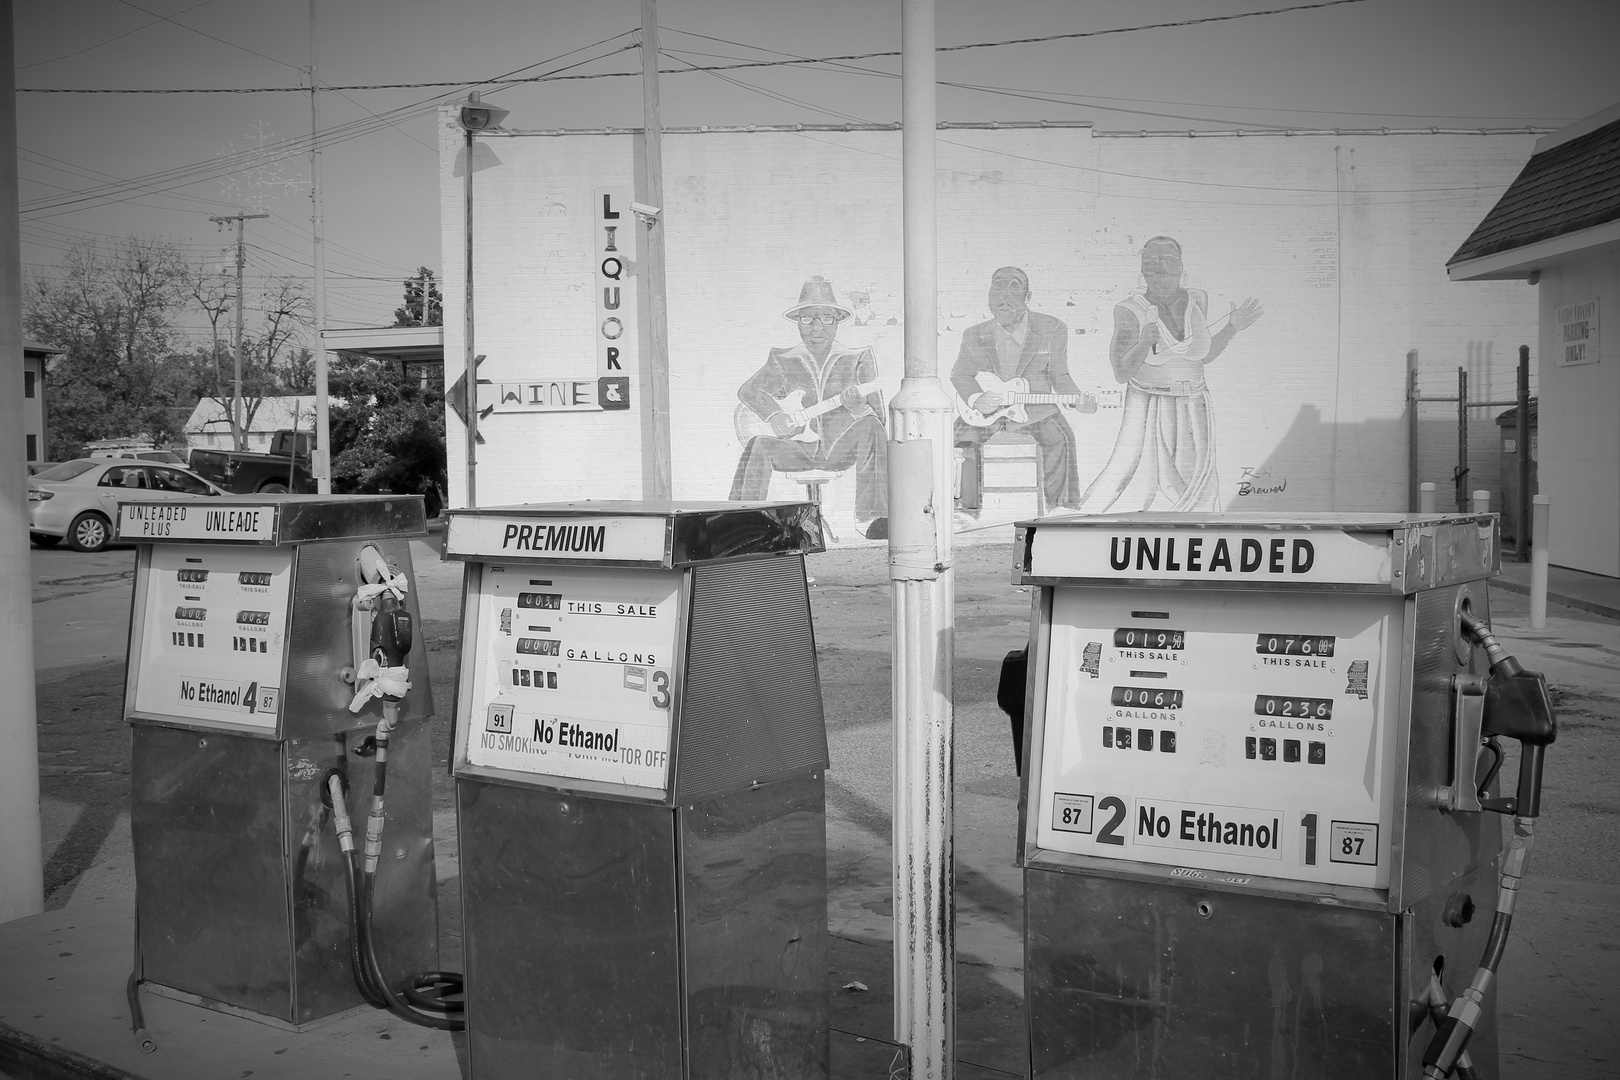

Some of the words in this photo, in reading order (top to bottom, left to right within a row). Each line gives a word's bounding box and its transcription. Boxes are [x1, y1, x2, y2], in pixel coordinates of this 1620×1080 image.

[602, 194, 623, 370] LIQUOR
[1565, 343, 1586, 362] ONLY!
[501, 382, 592, 406] WINE
[129, 506, 188, 522] UNLEADED
[205, 511, 260, 533] UNLEADE
[143, 521, 172, 537] PLUS
[502, 524, 606, 553] PREMIUM
[1109, 536, 1316, 574] UNLEADED
[568, 602, 602, 613] THIS
[617, 604, 657, 616] SALE
[566, 649, 656, 664] GALLONS
[1149, 652, 1178, 661] SALE
[1262, 657, 1291, 666] THIS
[1295, 659, 1327, 668] SALE
[180, 679, 195, 701] No
[198, 682, 241, 706] Ethanol
[242, 681, 258, 714] 4
[652, 670, 671, 709] 3
[263, 696, 273, 708] 87
[494, 713, 505, 727] 91
[1115, 709, 1176, 721] GALLONS
[1258, 719, 1324, 731] GALLONS
[480, 732, 496, 750] NO
[533, 718, 554, 744] No
[558, 722, 619, 753] Ethanol
[645, 750, 667, 768] OFF
[1062, 807, 1082, 825] 87
[1096, 796, 1127, 846] 2
[1138, 806, 1171, 839] No
[1180, 809, 1279, 850] Ethanol
[1301, 813, 1318, 866] 1
[1342, 837, 1365, 856] 87
